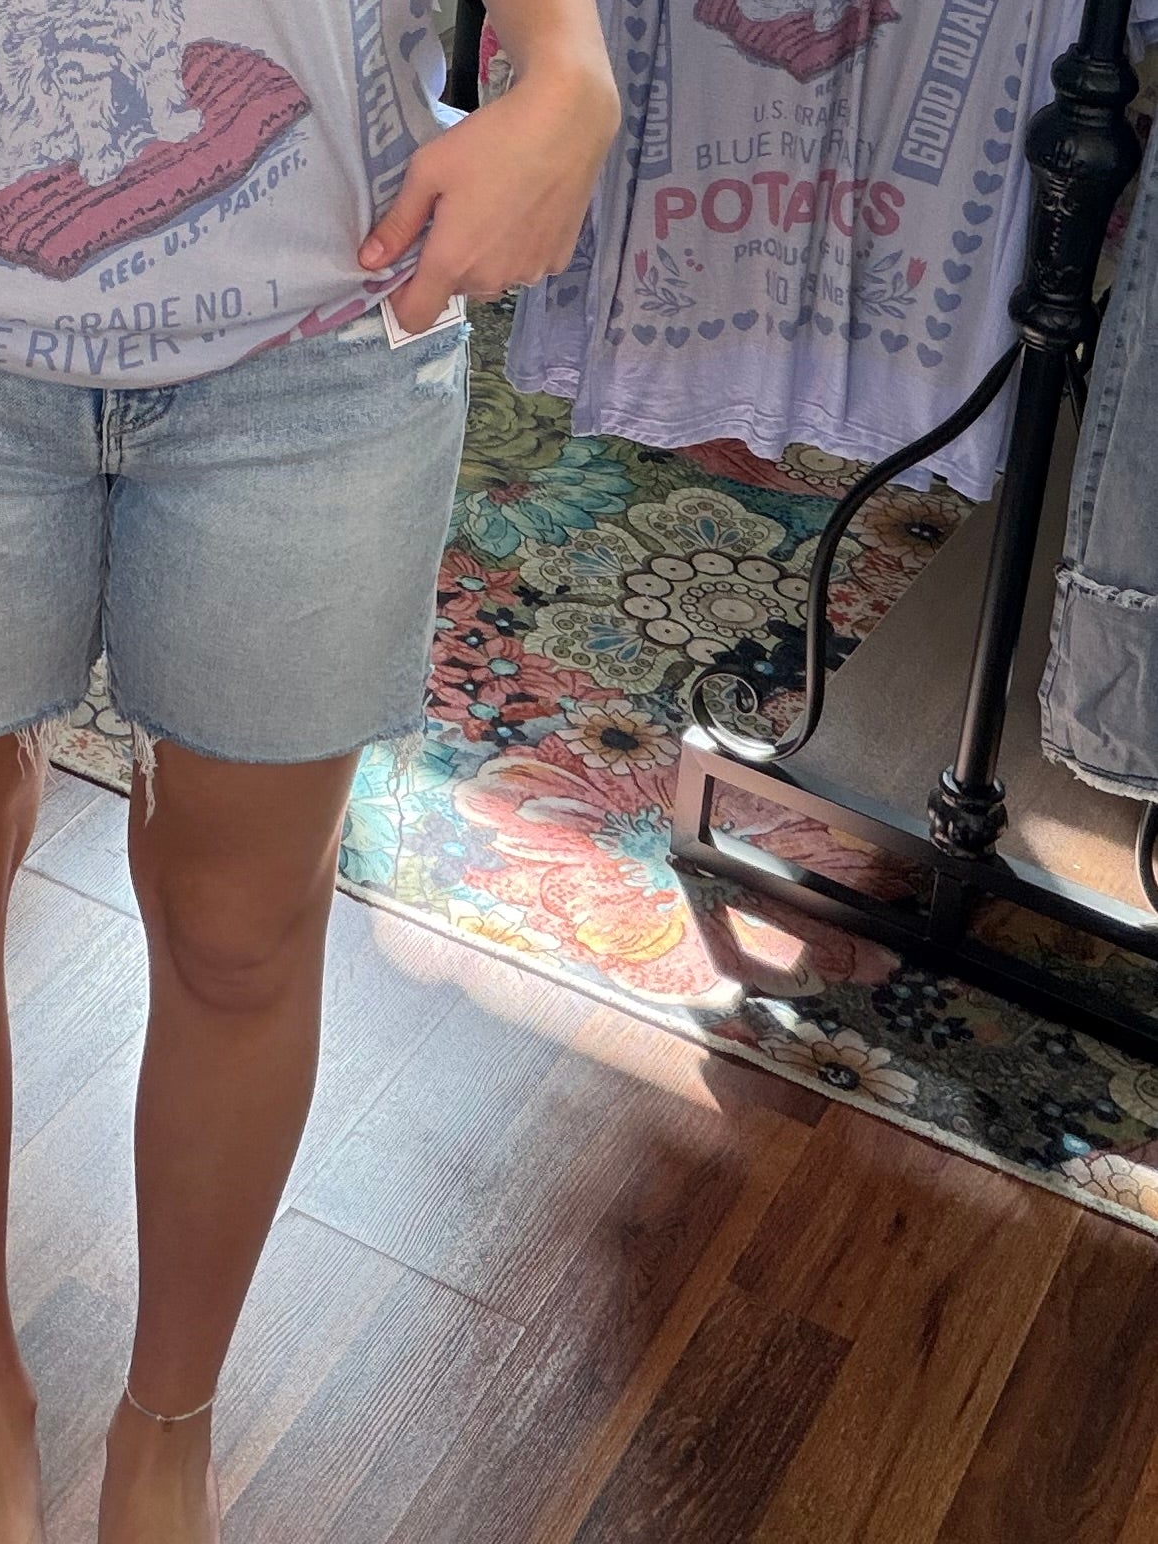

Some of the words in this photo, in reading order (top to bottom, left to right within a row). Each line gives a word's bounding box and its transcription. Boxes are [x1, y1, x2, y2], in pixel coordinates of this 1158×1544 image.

[753, 100, 788, 123] U.S.
[901, 79, 963, 170] GOOD
[696, 131, 772, 171] BLUE
[98, 251, 155, 293] REG.
[164, 219, 209, 257] U.S.
[55, 296, 181, 335] GRADE
[195, 287, 253, 321] NO.
[266, 279, 279, 309] 1
[25, 328, 181, 377] RIVER
